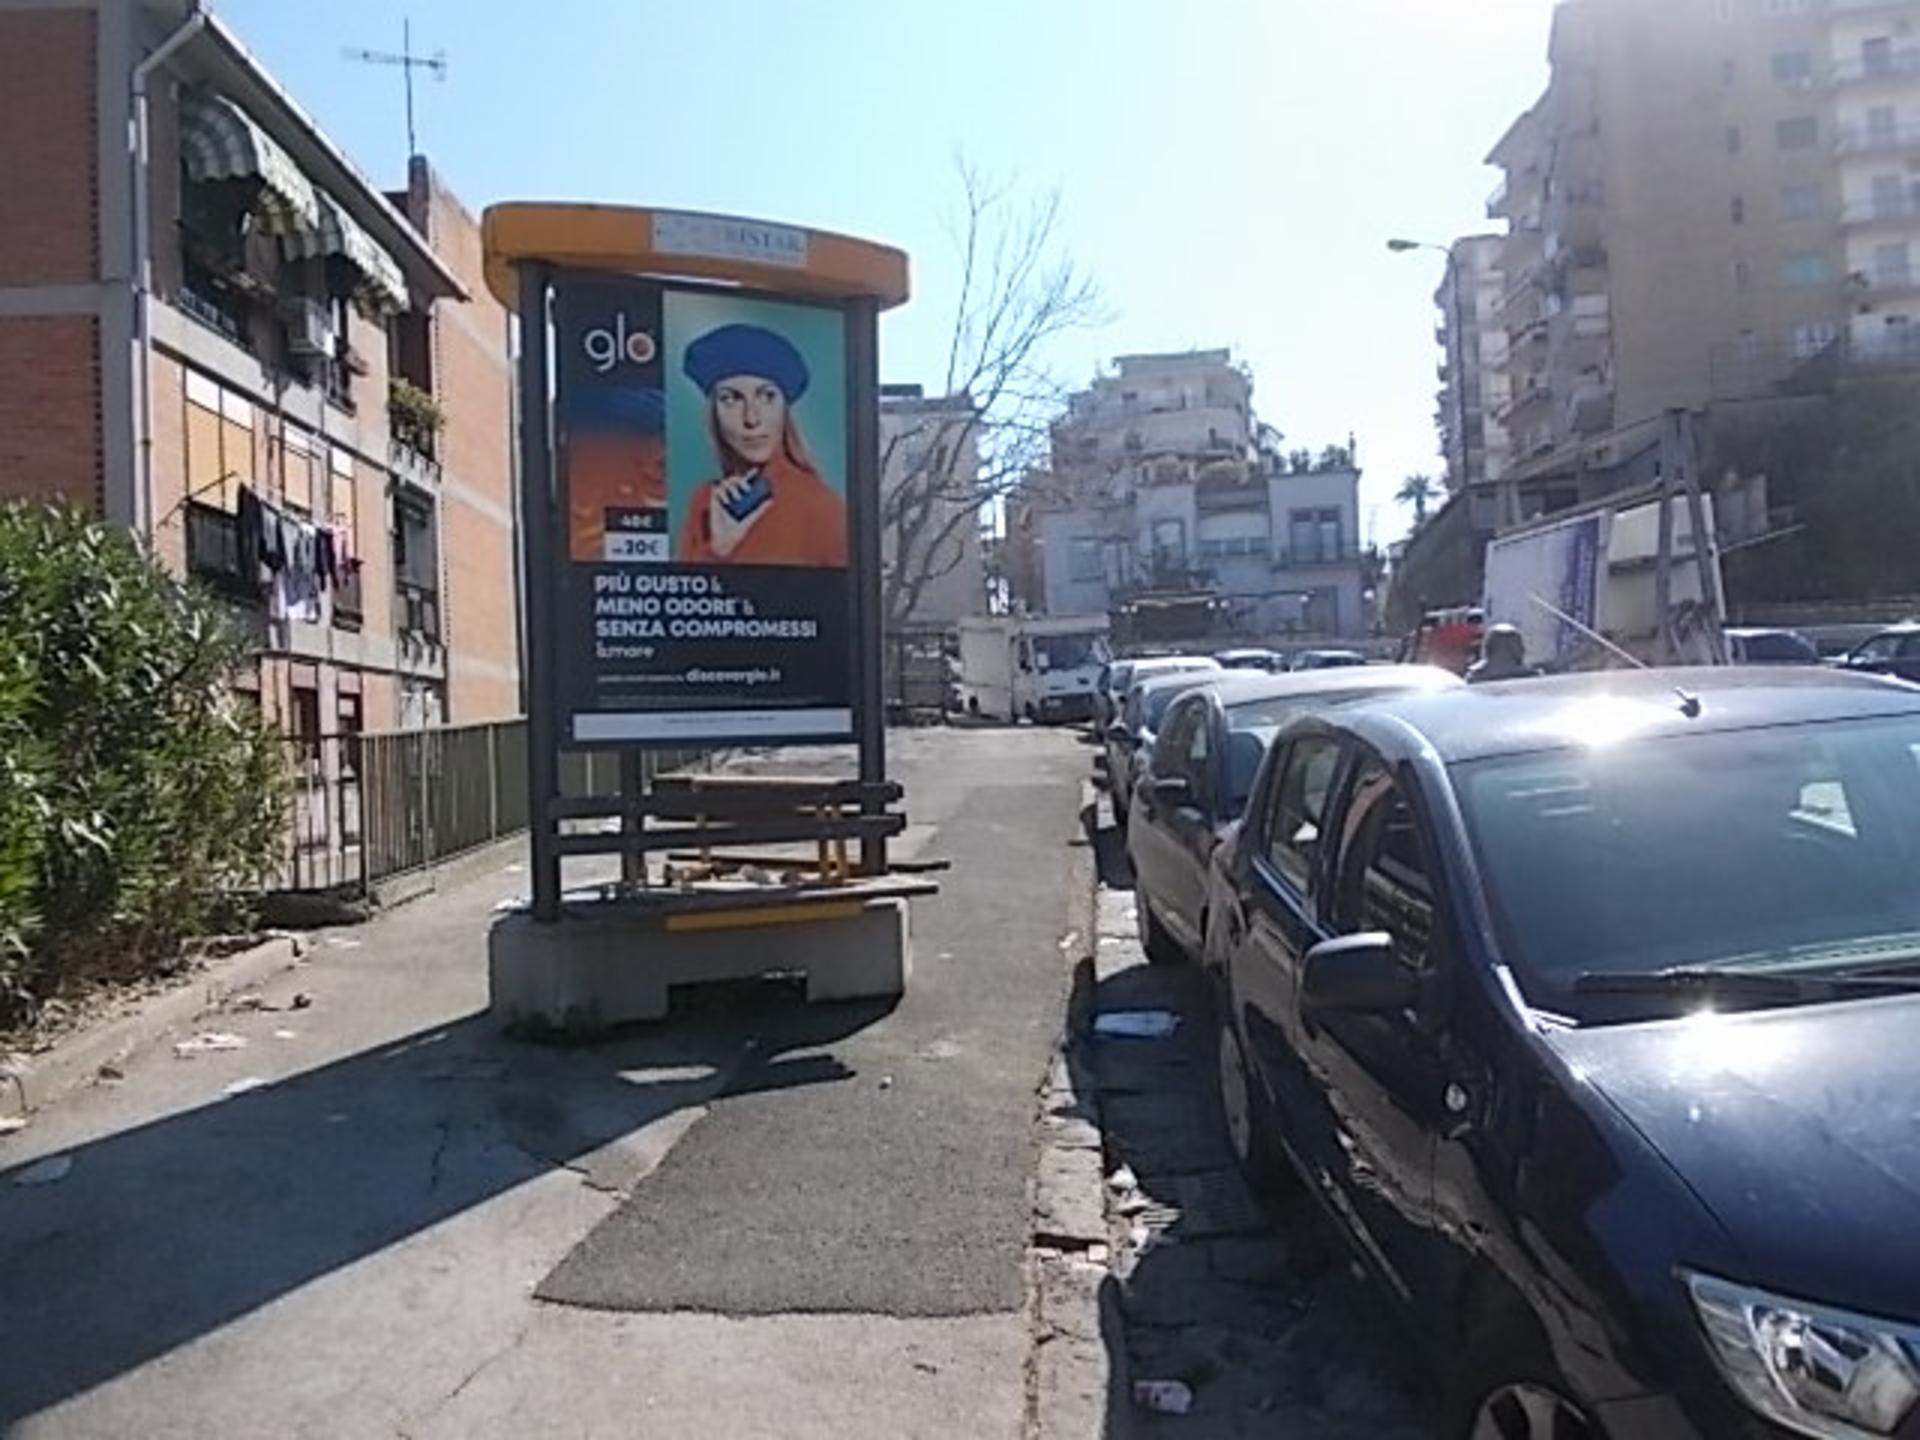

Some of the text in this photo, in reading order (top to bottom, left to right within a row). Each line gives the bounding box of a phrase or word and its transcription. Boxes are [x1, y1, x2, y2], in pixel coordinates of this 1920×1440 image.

[584, 312, 656, 372] glo
[594, 571, 630, 593] PIÙ
[635, 575, 708, 593] GUSTO
[595, 597, 661, 616] MENO
[664, 597, 736, 616] ODORE
[595, 619, 817, 637] SENZA COMPROMESSI
